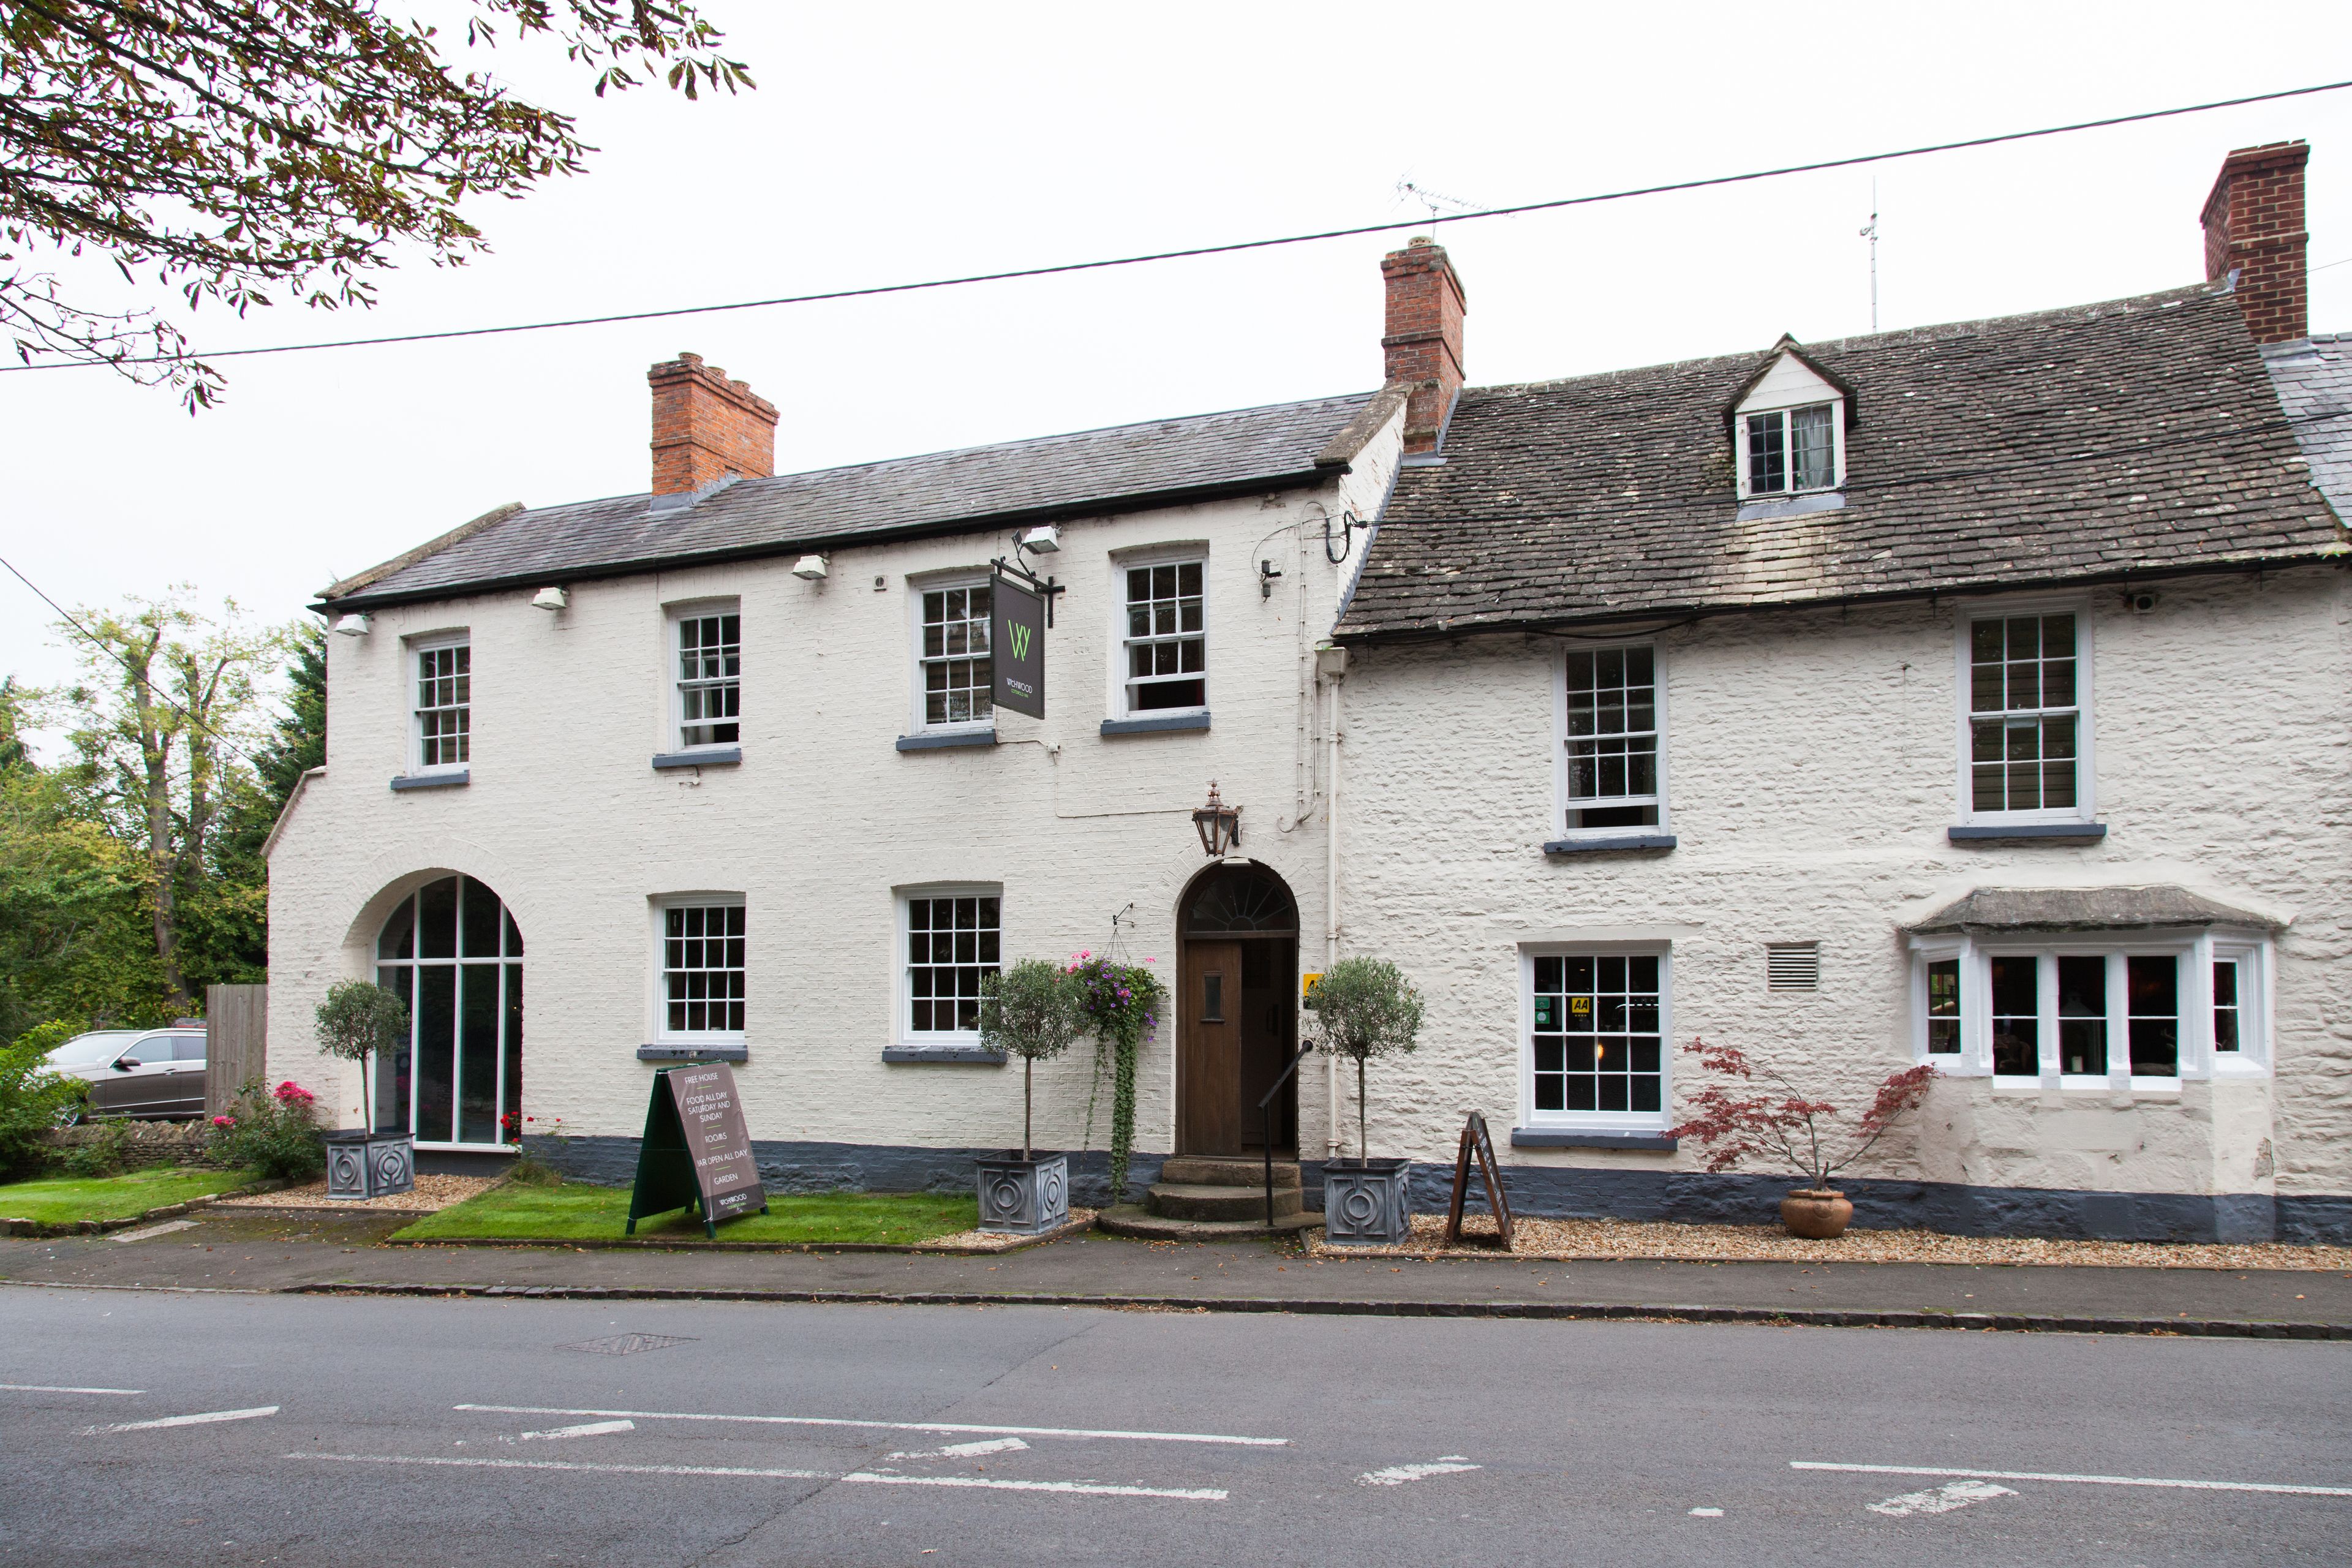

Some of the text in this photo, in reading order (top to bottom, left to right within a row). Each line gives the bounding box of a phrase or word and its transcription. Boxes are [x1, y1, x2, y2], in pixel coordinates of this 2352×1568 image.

[1574, 1000, 1588, 1010] AA
[685, 1072, 718, 1084] FREE HOUSE
[687, 1091, 727, 1105] FOOD ALL DAY
[688, 1101, 730, 1115] SATURDAY AND
[699, 1112, 722, 1123] SUNDAY
[705, 1132, 727, 1143] ROOMS
[707, 1155, 723, 1165] OPEN
[724, 1152, 734, 1161] ALL
[734, 1148, 747, 1158] DAY
[714, 1172, 739, 1185] GARDEN
